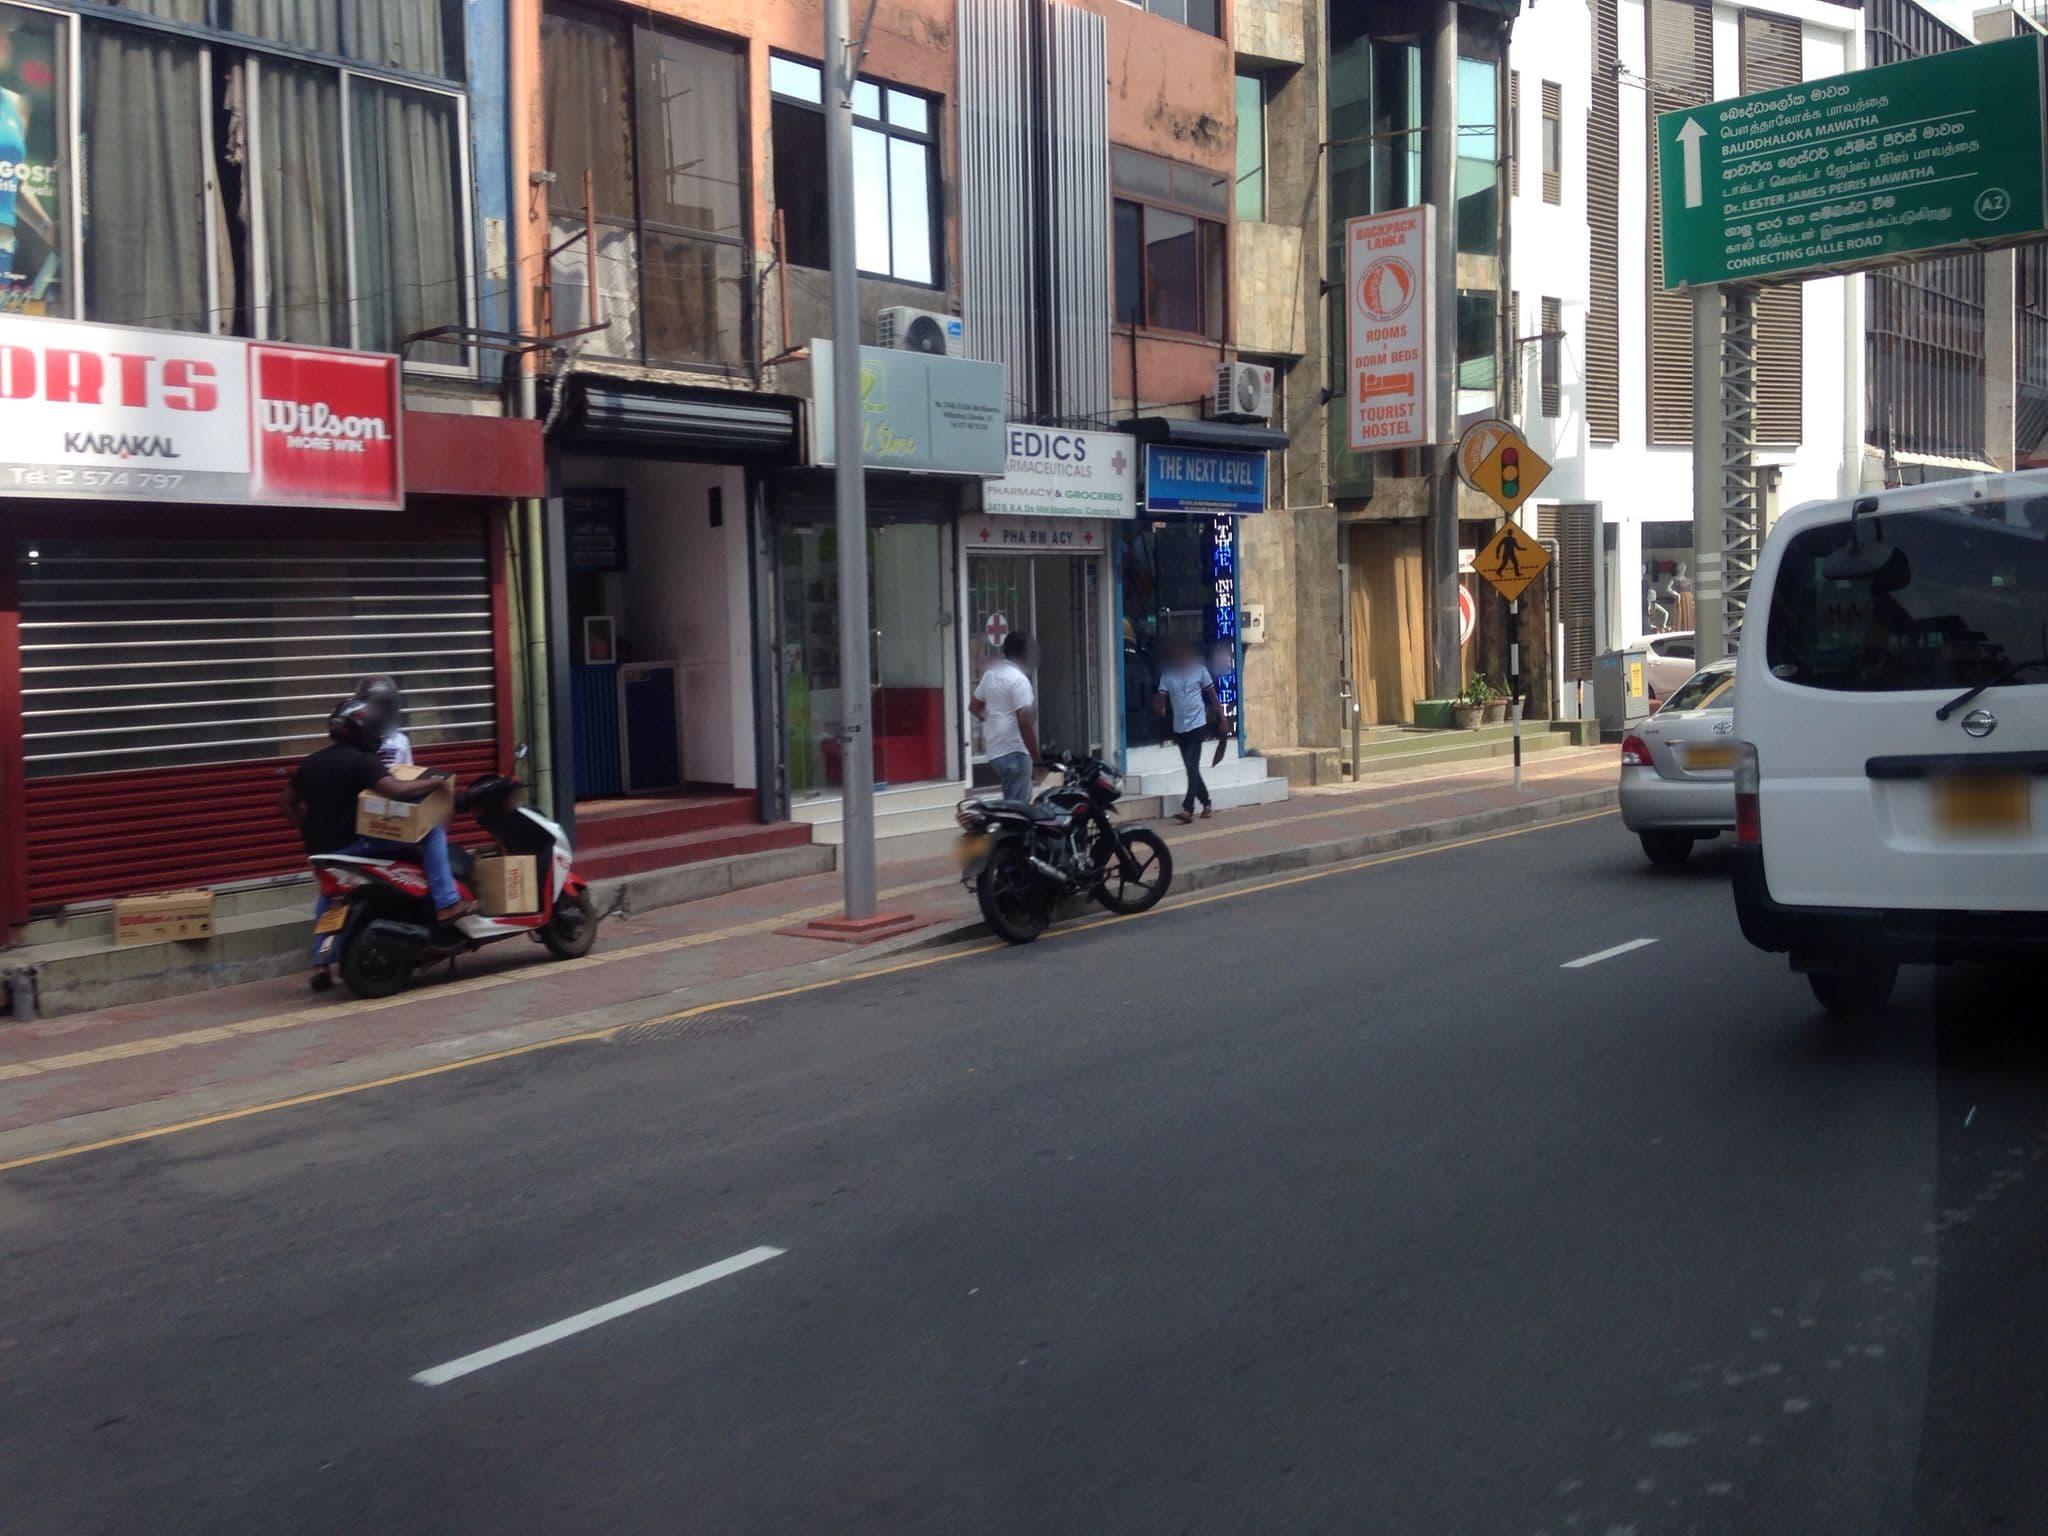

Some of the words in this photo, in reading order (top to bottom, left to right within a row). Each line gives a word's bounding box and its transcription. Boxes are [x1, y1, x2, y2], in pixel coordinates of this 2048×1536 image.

[1810, 85, 1850, 101] මාවත
[1826, 95, 1889, 117] மாவத்தை
[1721, 128, 1813, 157] BAUDDHALOKA
[1815, 114, 1880, 137] MAWATHA
[1922, 123, 1965, 139] මාවත
[1914, 139, 1980, 160] மாவத்தை
[1723, 203, 1741, 215] Dr.
[1741, 193, 1786, 212] LESTER
[1787, 186, 1827, 203] JAMES
[1828, 179, 1868, 196] PEIRIS
[1868, 166, 1936, 188] MAWATHA
[1981, 196, 2004, 212] A2
[1356, 218, 1416, 241] BACKPACK
[1368, 233, 1405, 251] LANKA
[1726, 247, 1804, 271] CONNECTING
[1805, 241, 1845, 261] GALLE
[1846, 234, 1883, 252] ROAD
[1366, 325, 1407, 342] ROOMS
[1355, 353, 1387, 368] DORM
[1391, 348, 1418, 363] BEDS
[260, 398, 390, 441] Wilson
[1359, 402, 1415, 422] TOURIST
[1362, 420, 1411, 439] HOSTEL
[64, 432, 181, 459] KARAKAL
[287, 436, 331, 452] MORE
[56, 469, 73, 486] 2
[81, 469, 130, 487] 574
[139, 473, 184, 490] 797
[1158, 456, 1183, 480] THE
[1186, 458, 1217, 483] NEXT
[1219, 461, 1253, 485] LEVEL
[987, 486, 1051, 498] PHARMACY
[1054, 489, 1062, 497] &
[1064, 490, 1123, 501] GROCERIES
